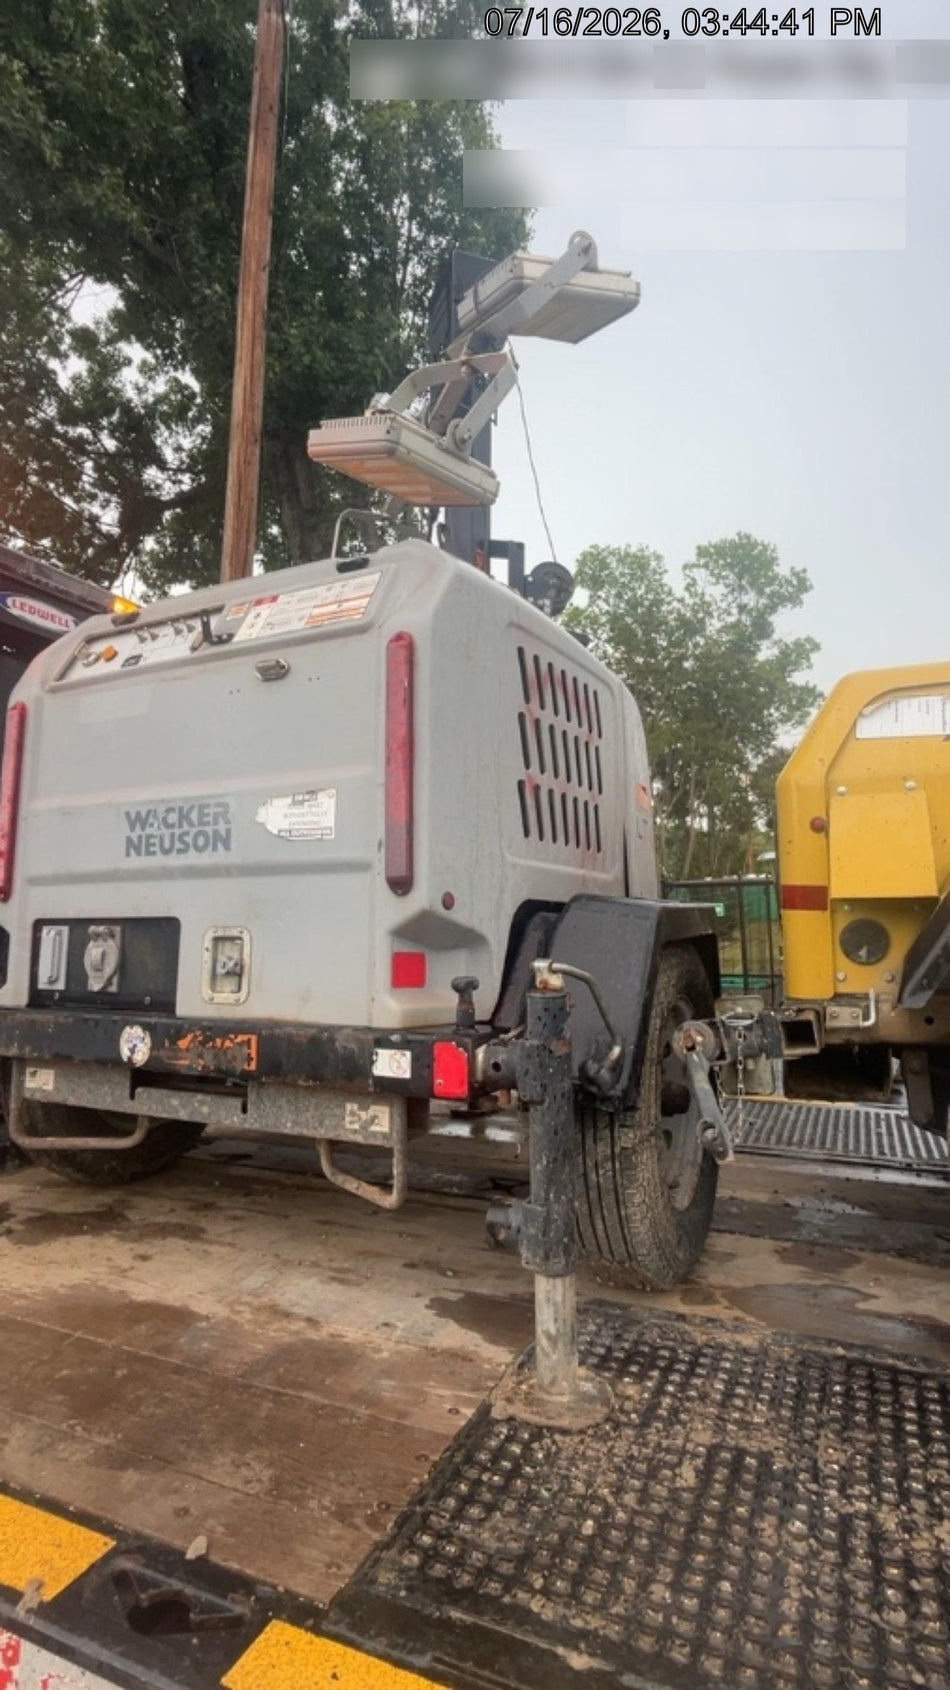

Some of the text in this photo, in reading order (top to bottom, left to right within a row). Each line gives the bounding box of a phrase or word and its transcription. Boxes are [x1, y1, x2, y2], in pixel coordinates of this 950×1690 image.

[12, 599, 70, 627] LEDWELL
[124, 801, 232, 832] WACKER
[125, 828, 232, 857] NEUSON
